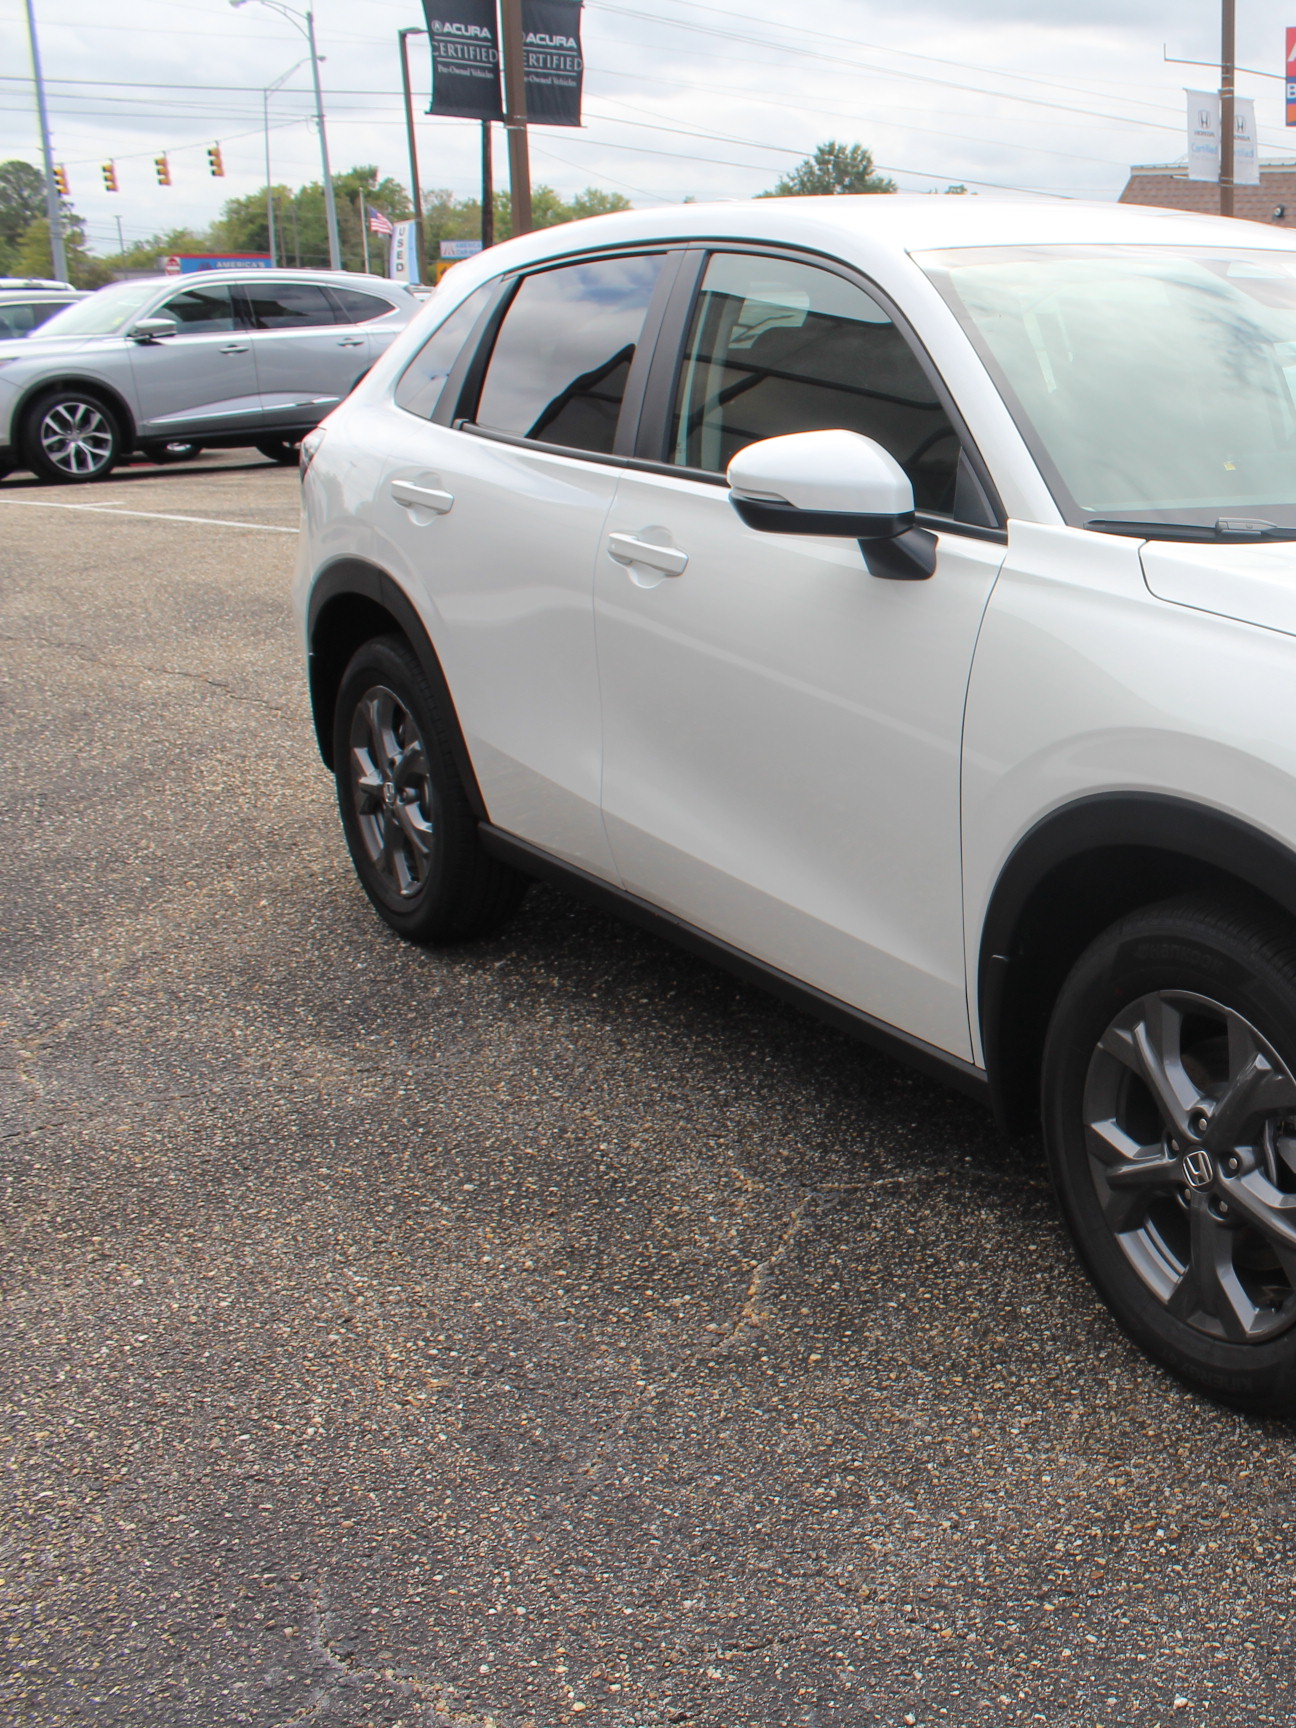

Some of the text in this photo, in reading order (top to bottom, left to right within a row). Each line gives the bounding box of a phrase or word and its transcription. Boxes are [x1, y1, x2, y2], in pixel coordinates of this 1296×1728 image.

[443, 22, 492, 39] ACURA
[526, 32, 577, 48] ACURA
[432, 41, 498, 62] CERTIFIED
[523, 52, 583, 71] ERTIFIED
[437, 64, 494, 79] Pre-Owned Vehicles
[553, 76, 577, 87] Vehicles
[1191, 142, 1217, 154] Certified
[396, 227, 405, 272] USED
